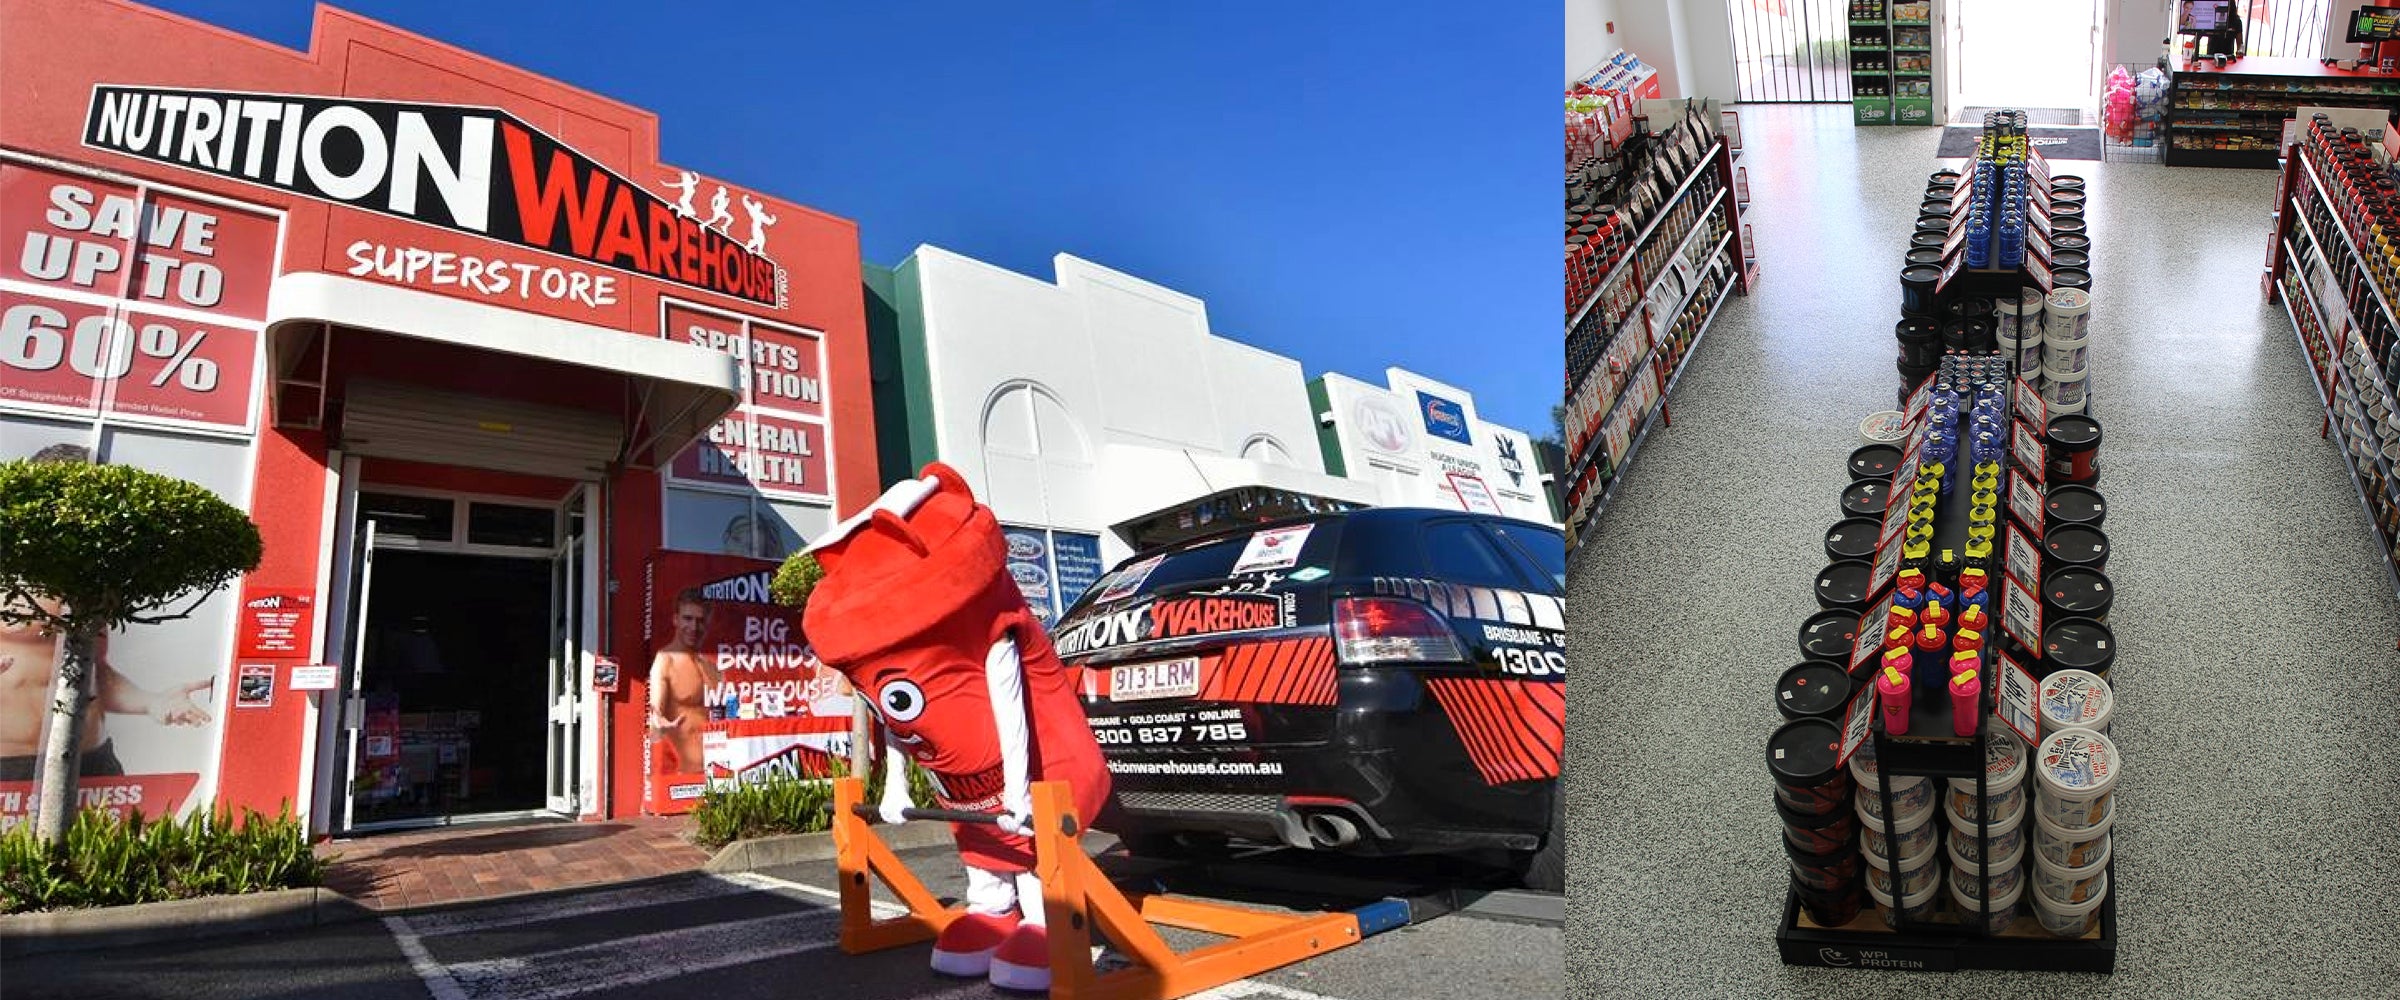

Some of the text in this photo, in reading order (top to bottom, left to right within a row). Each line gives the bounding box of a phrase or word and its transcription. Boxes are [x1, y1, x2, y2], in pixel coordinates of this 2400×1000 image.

[97, 92, 776, 303] NUTRITION WAREHOUSE
[46, 184, 218, 257] SAVE
[19, 231, 224, 308] UP TO
[346, 241, 617, 307] SUPERSTORE
[0, 304, 219, 393] 60%
[689, 325, 799, 371] SPORTS
[708, 418, 812, 456] ENERAL
[700, 444, 804, 485] HEALTH
[744, 616, 789, 643] BIG
[1150, 597, 1275, 639] WAREHOUSE
[1482, 624, 1544, 646] BRISBANE
[717, 643, 817, 673] BRANDS
[1093, 723, 1247, 744] 300 837 785
[1129, 716, 1153, 725] GOLD
[1154, 713, 1187, 724] COAST
[1199, 709, 1242, 721] ONLINE
[1859, 950, 1888, 959] WPI
[1860, 958, 1923, 968] PROTEIN
